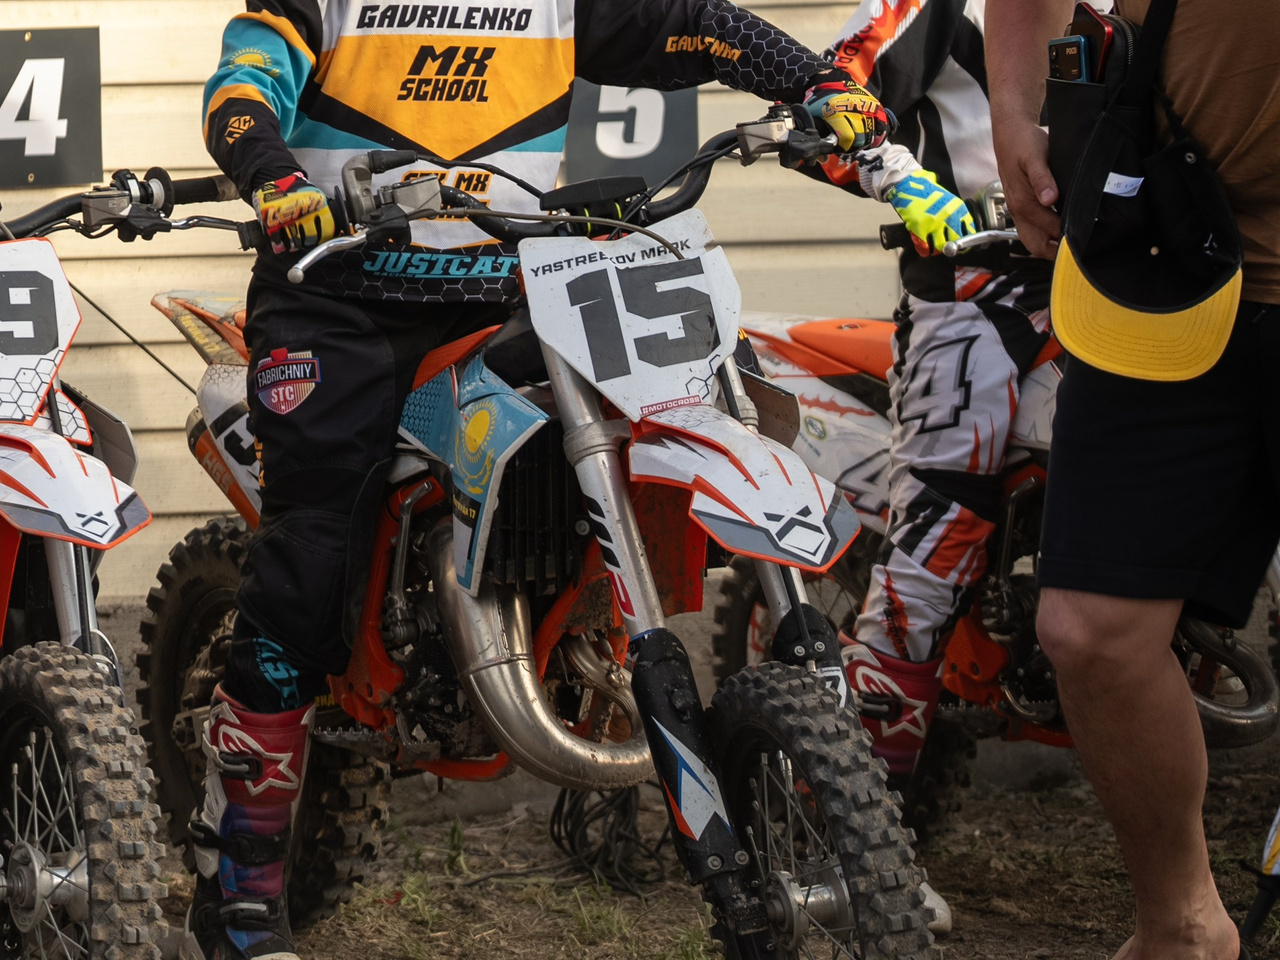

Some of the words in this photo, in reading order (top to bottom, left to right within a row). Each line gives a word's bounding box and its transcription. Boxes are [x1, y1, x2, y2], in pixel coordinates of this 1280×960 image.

[356, 4, 533, 32] GAVRILENKO
[407, 45, 496, 78] MX
[397, 76, 490, 103] SCHOOL
[595, 84, 666, 160] 5
[454, 172, 491, 192] MX
[565, 256, 722, 383] 15
[257, 363, 313, 389] FABRICHNIY
[271, 385, 295, 403] STC
[641, 395, 701, 415] #MOTOCROSS
